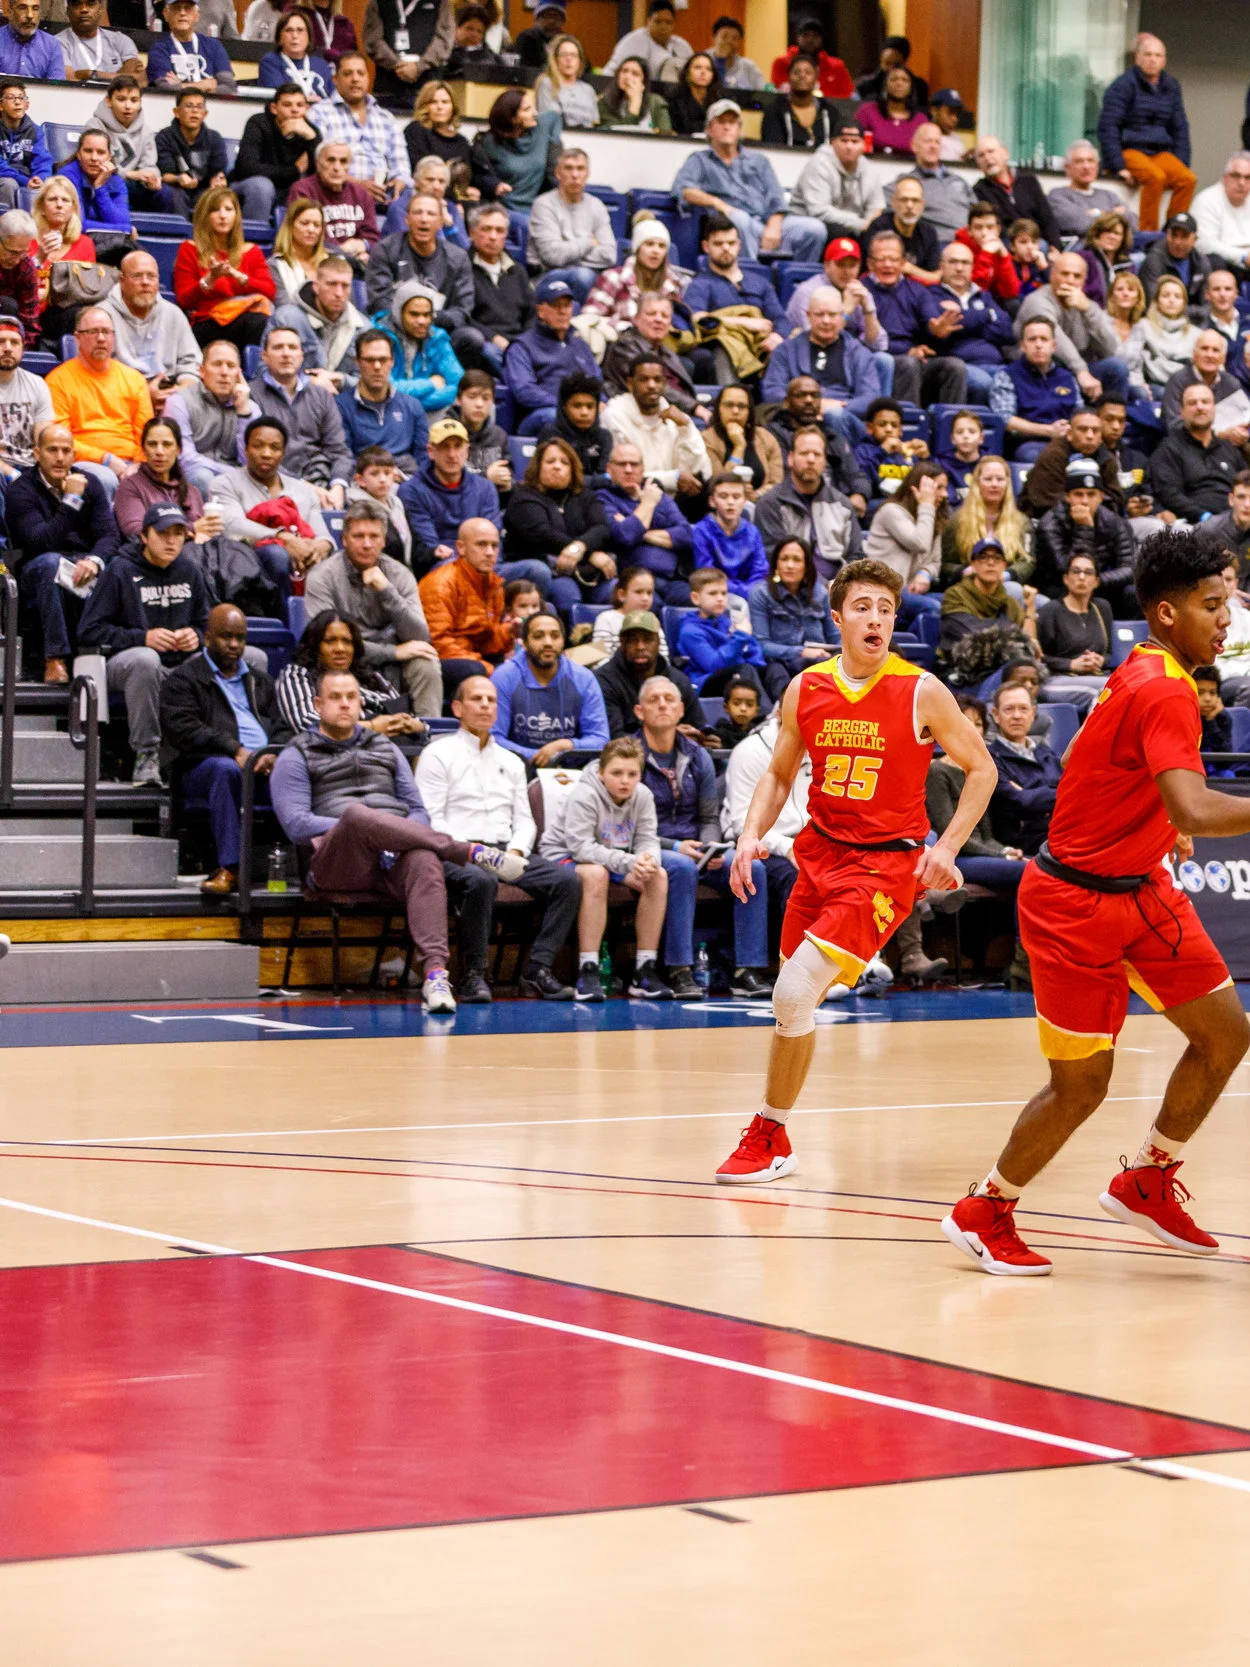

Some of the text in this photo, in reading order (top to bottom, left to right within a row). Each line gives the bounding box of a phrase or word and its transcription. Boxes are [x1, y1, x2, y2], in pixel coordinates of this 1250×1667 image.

[140, 583, 192, 603] BULLDOGS
[822, 719, 880, 737] BERGEN
[814, 733, 886, 751] CATHOLIC
[820, 753, 884, 801] 25
